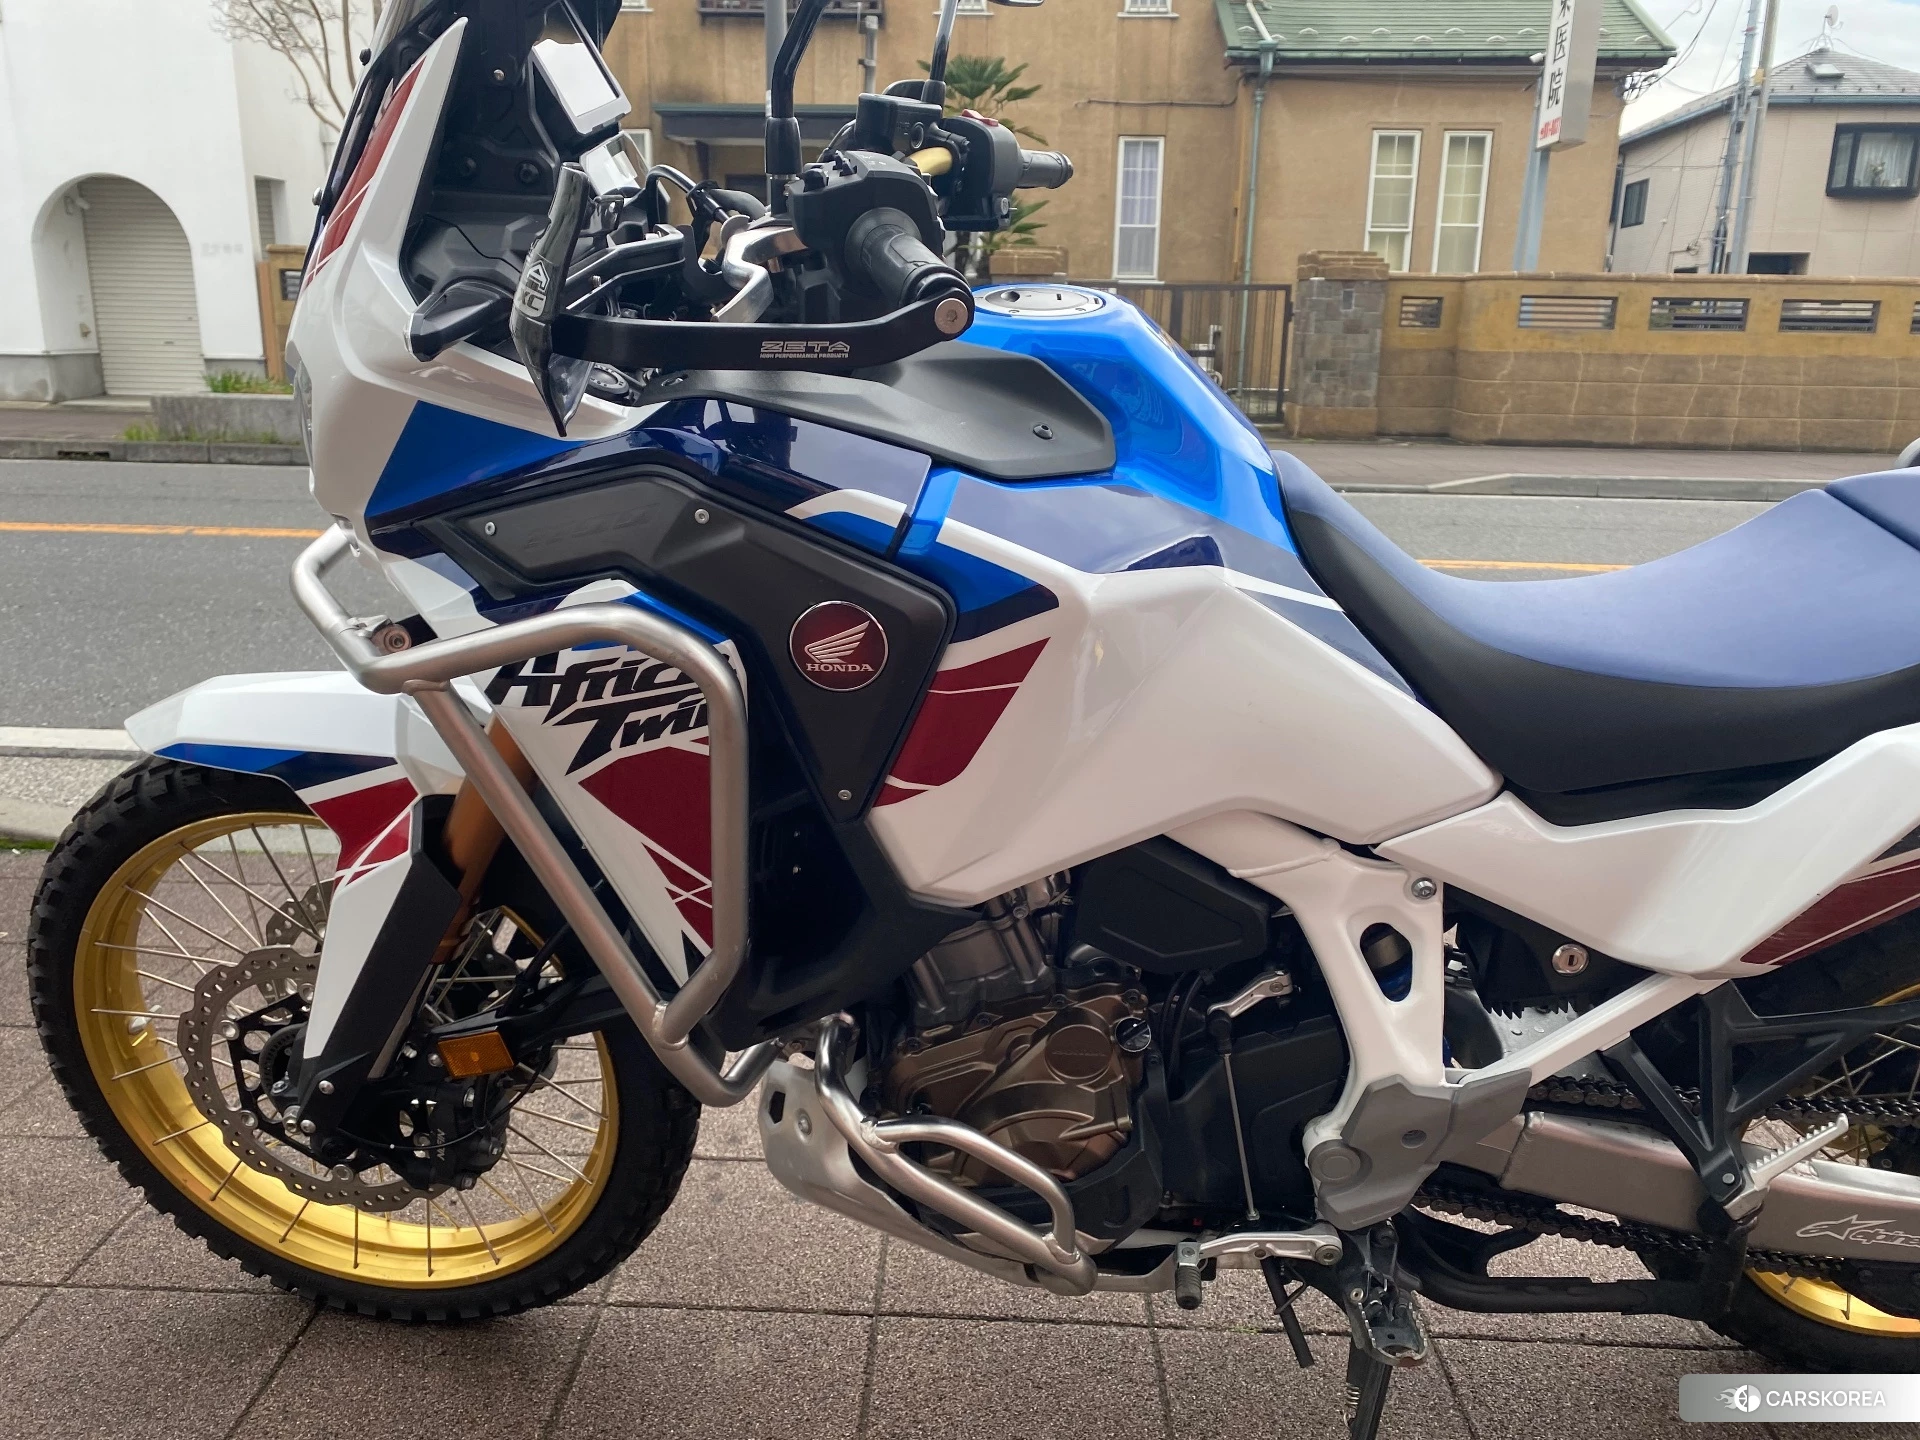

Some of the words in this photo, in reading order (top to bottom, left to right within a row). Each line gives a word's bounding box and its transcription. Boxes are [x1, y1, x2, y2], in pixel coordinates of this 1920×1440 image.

[760, 340, 851, 353] ZETA
[484, 650, 702, 726] Afric
[805, 662, 875, 672] HONDA
[552, 687, 709, 777] Twi
